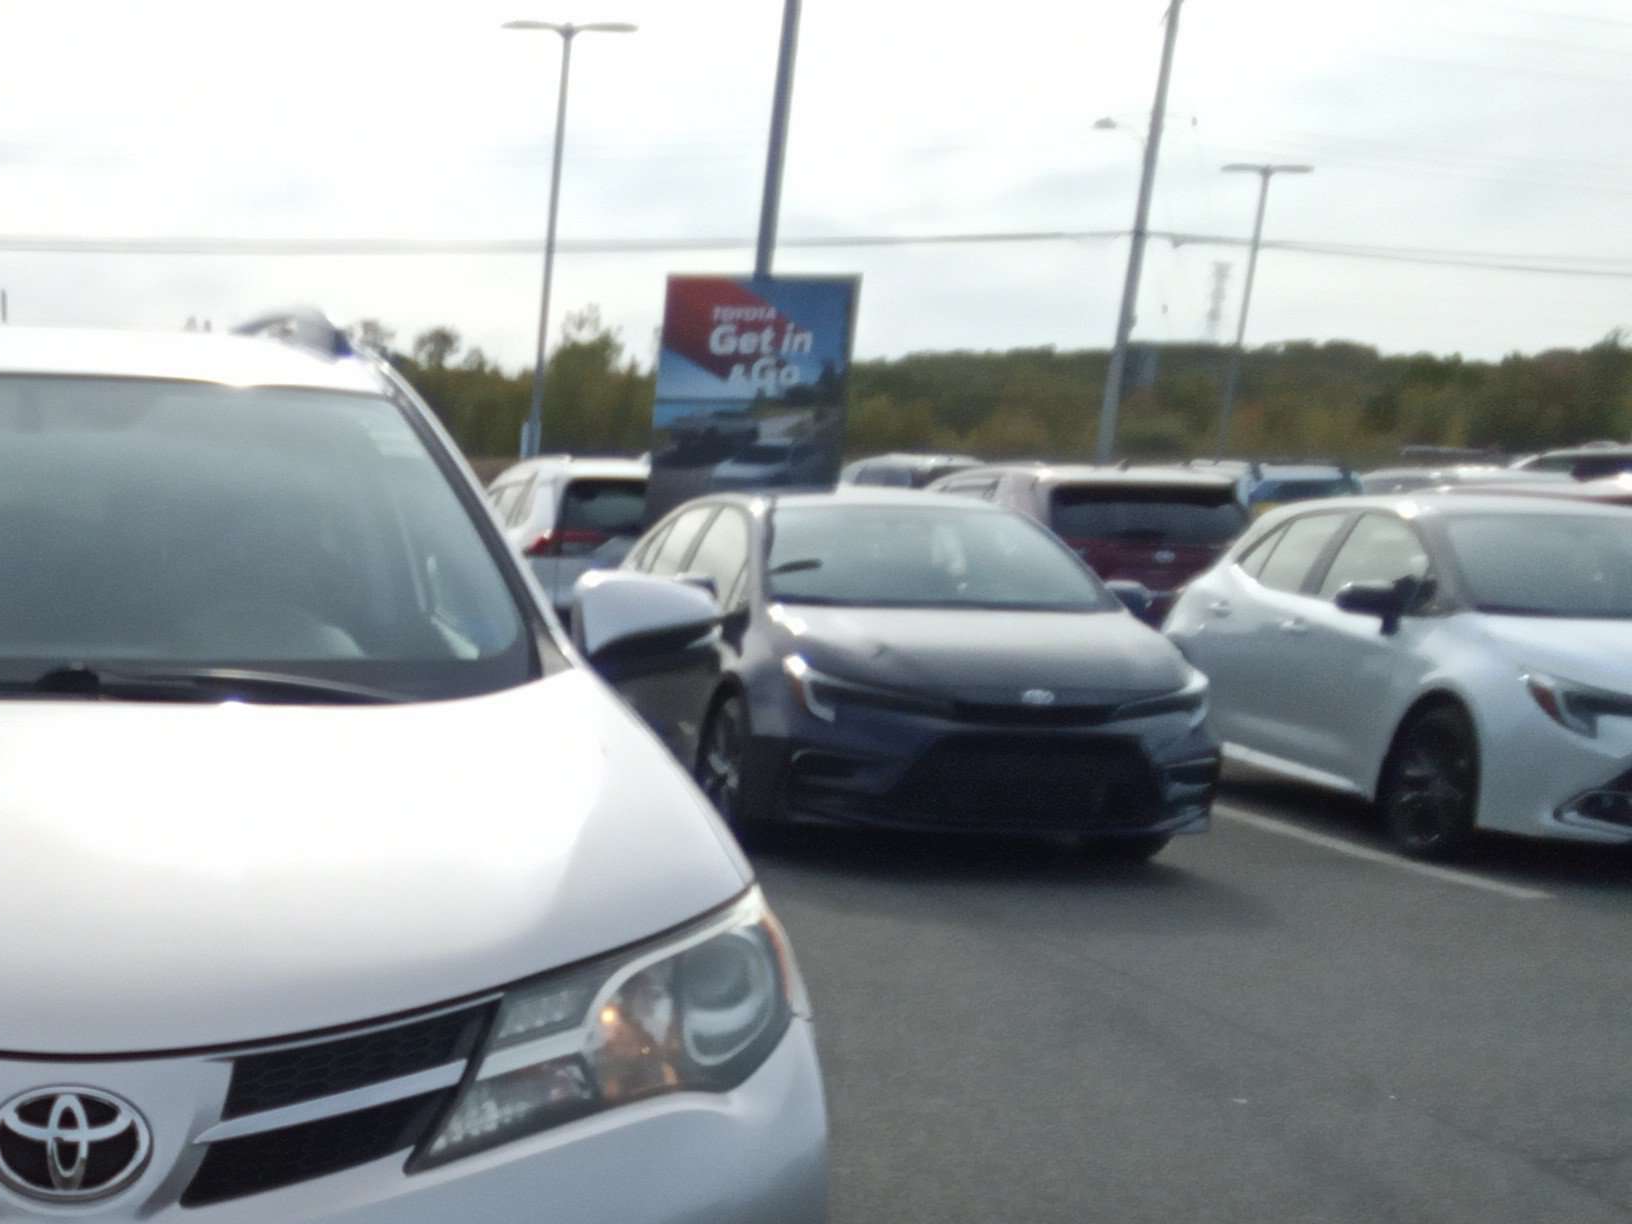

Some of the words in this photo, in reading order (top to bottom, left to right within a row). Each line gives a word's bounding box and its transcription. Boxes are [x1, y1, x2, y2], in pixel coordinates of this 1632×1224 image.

[712, 305, 776, 321] TOYOTA
[709, 323, 775, 355] Get
[781, 322, 814, 354] in
